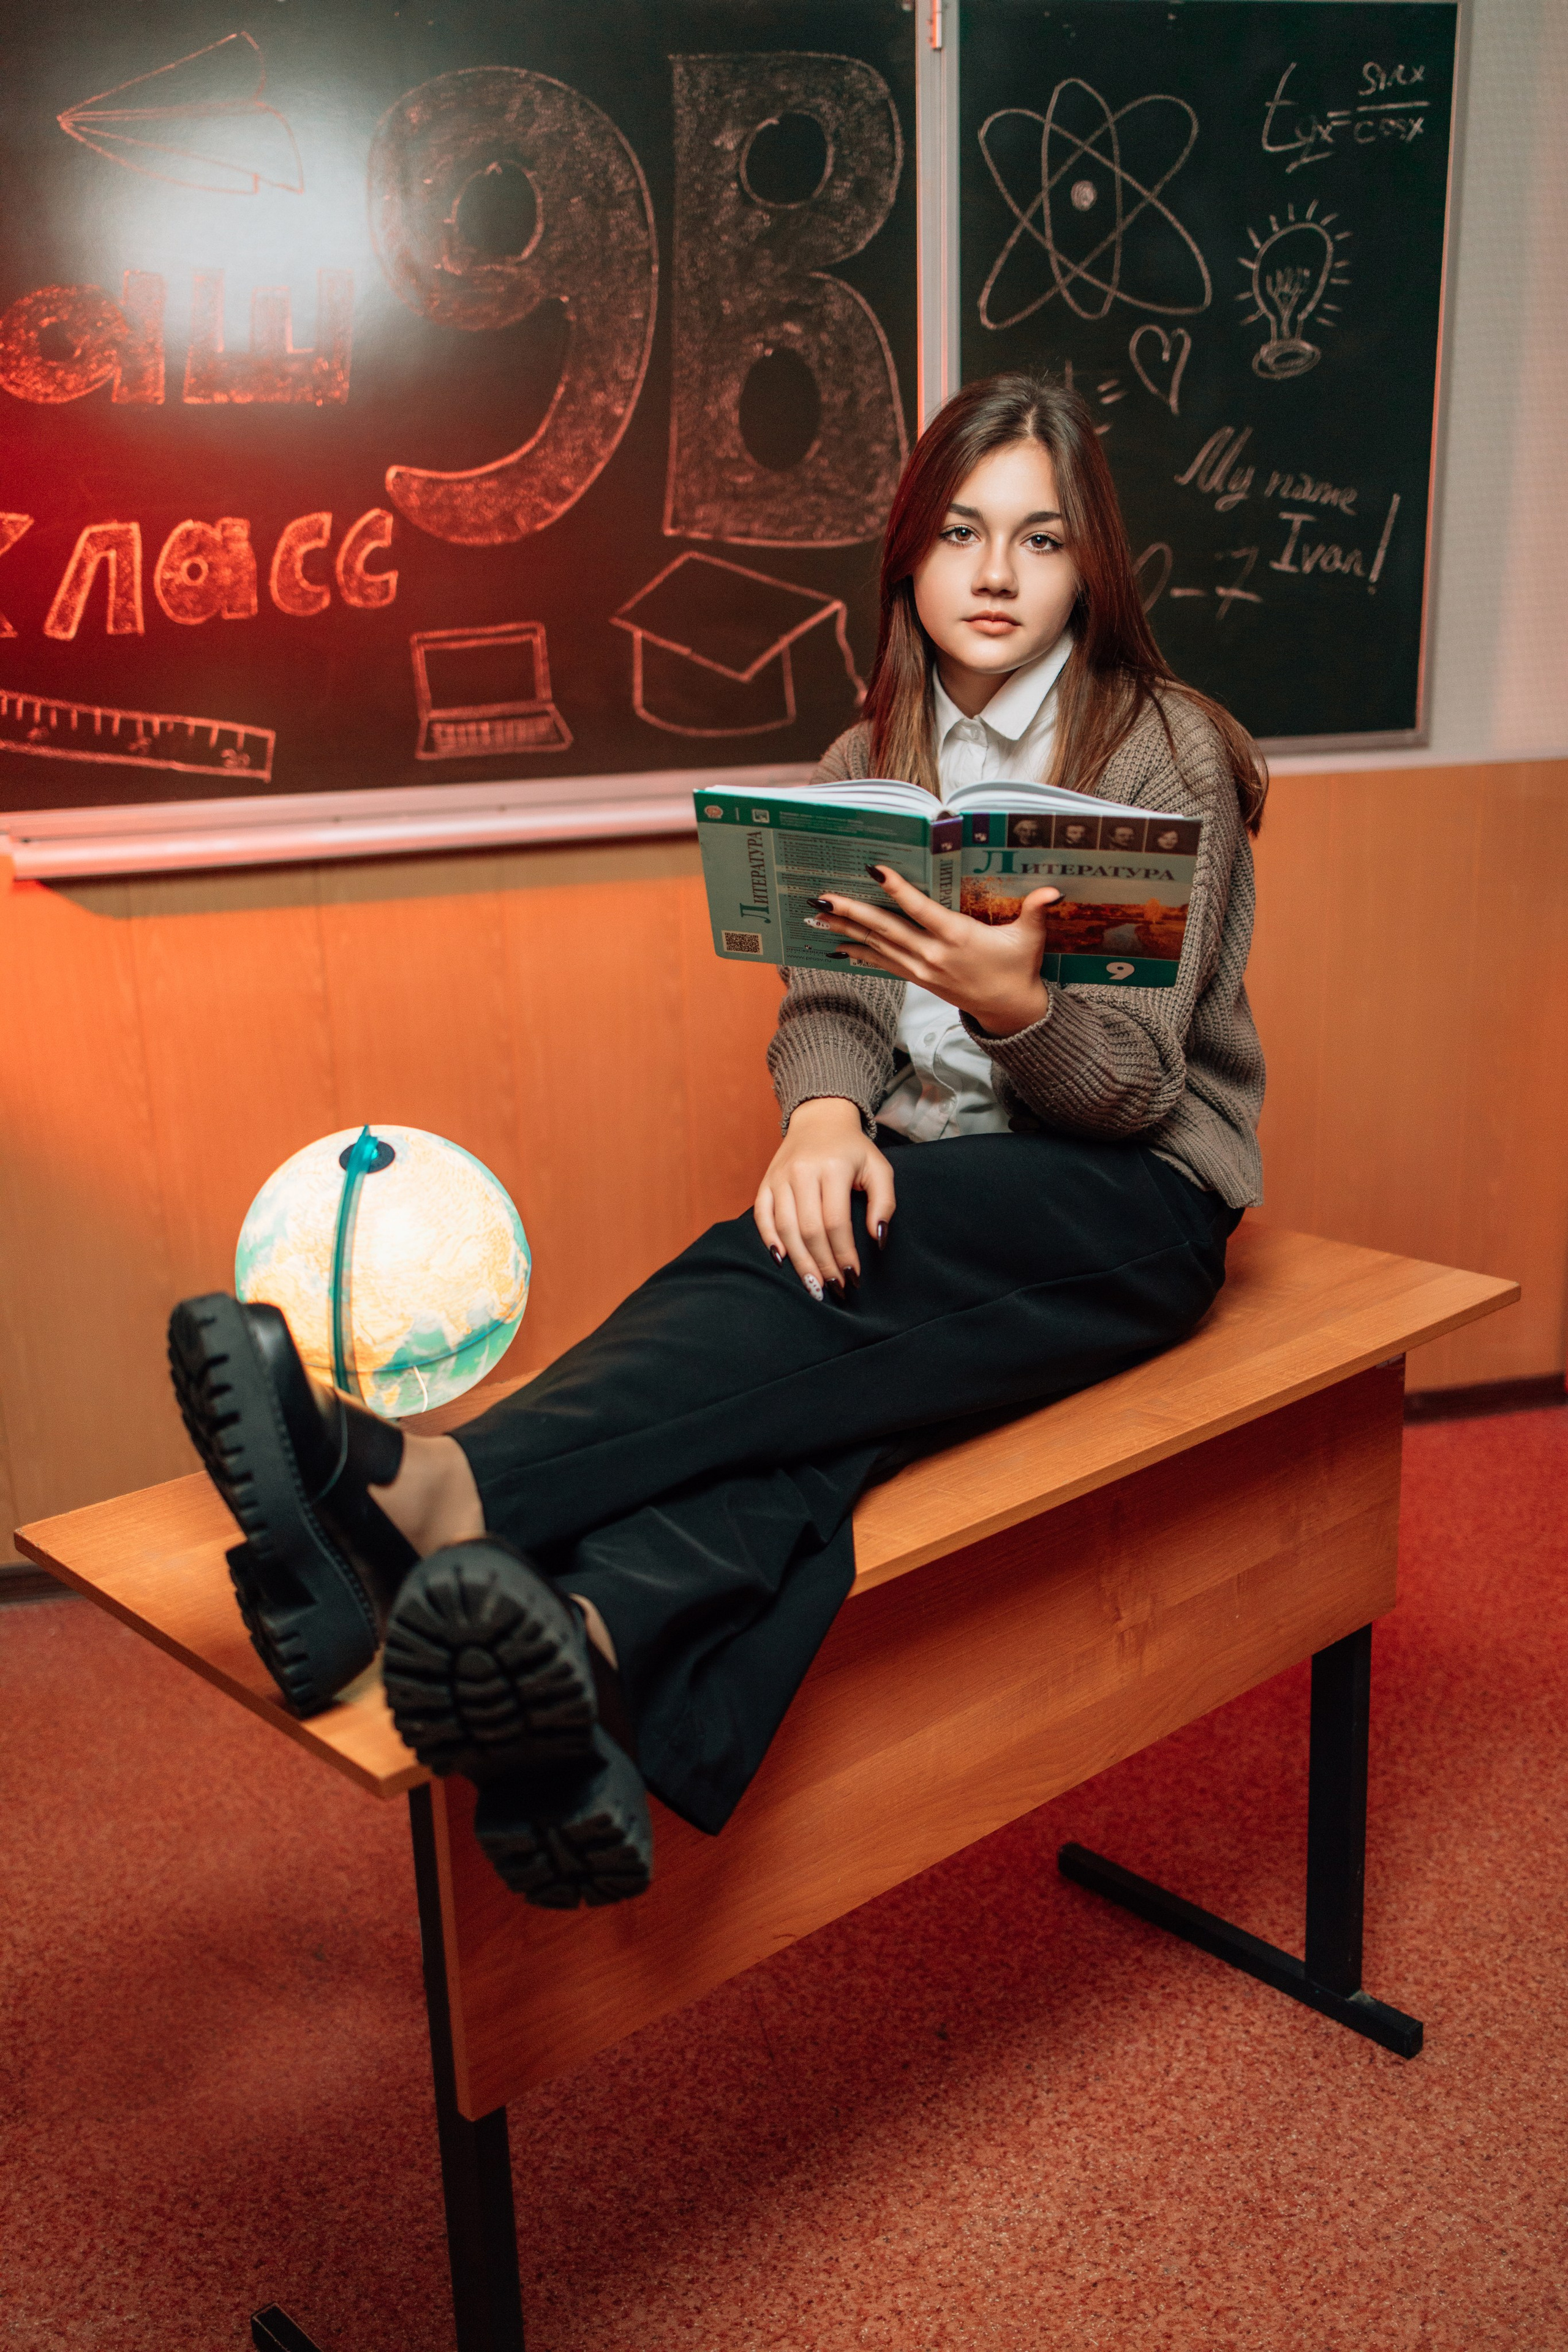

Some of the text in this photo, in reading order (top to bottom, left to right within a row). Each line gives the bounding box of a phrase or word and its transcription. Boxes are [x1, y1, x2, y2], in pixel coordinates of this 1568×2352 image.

[1174, 425, 1359, 516] My name
[786, 954, 832, 963] www.prosv.ru
[1106, 962, 1135, 980] 9
